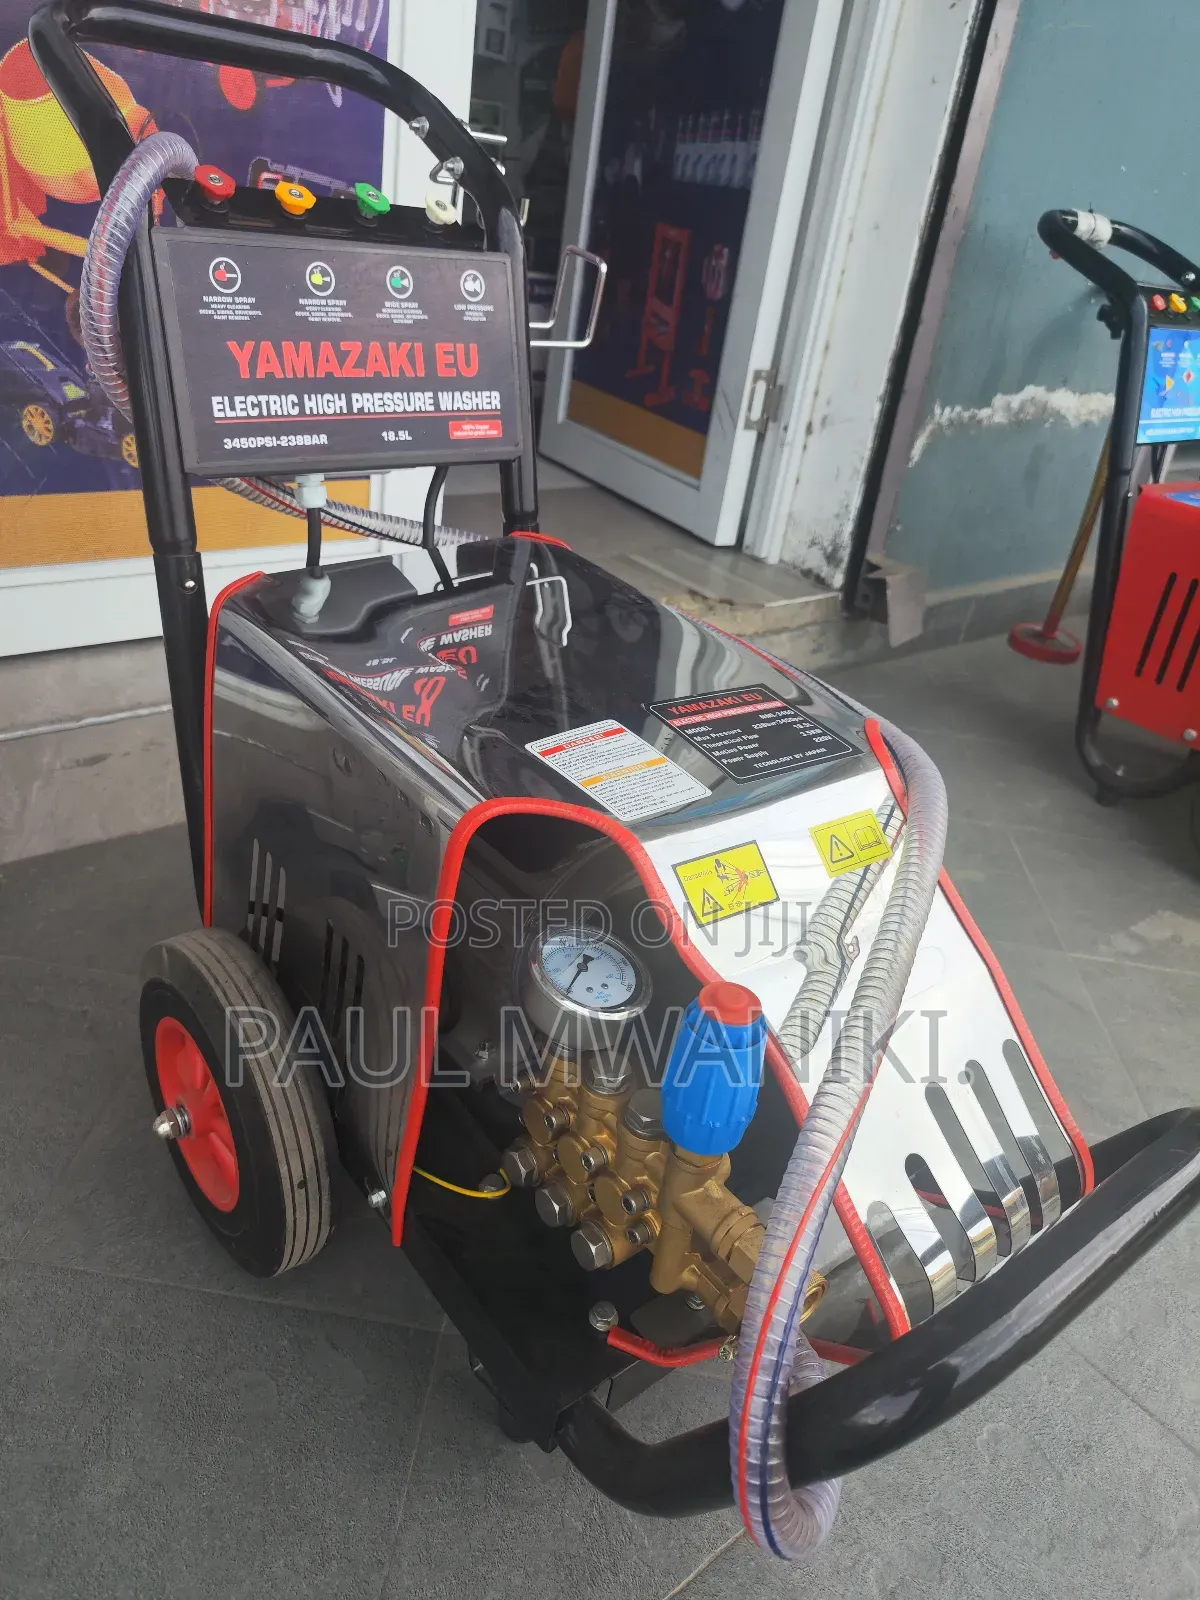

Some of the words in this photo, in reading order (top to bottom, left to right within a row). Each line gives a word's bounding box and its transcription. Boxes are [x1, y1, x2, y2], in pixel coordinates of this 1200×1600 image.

[234, 296, 256, 304] SPRAY
[298, 298, 327, 306] NARROW
[226, 340, 426, 378] YAMAZAKI
[435, 342, 480, 378] EU
[211, 394, 300, 418] ELECTRIC
[304, 394, 348, 415] HIGH
[351, 392, 434, 414] PRESSURE
[438, 390, 501, 411] WASHER
[223, 434, 328, 450] 3450PSI-238BAR
[382, 430, 412, 442] 18.5L
[667, 695, 740, 716] YAMAZAKI
[743, 692, 763, 703] EU
[672, 714, 705, 726] ELECTRIC
[705, 711, 722, 721] HIGH
[684, 725, 713, 736] MODEL
[694, 734, 710, 742] Max
[711, 728, 742, 741] Pressure
[702, 736, 743, 750] Theoretical
[744, 734, 760, 742] Flow
[738, 742, 760, 752] Power
[722, 755, 744, 766] Power
[744, 750, 770, 762] Supply
